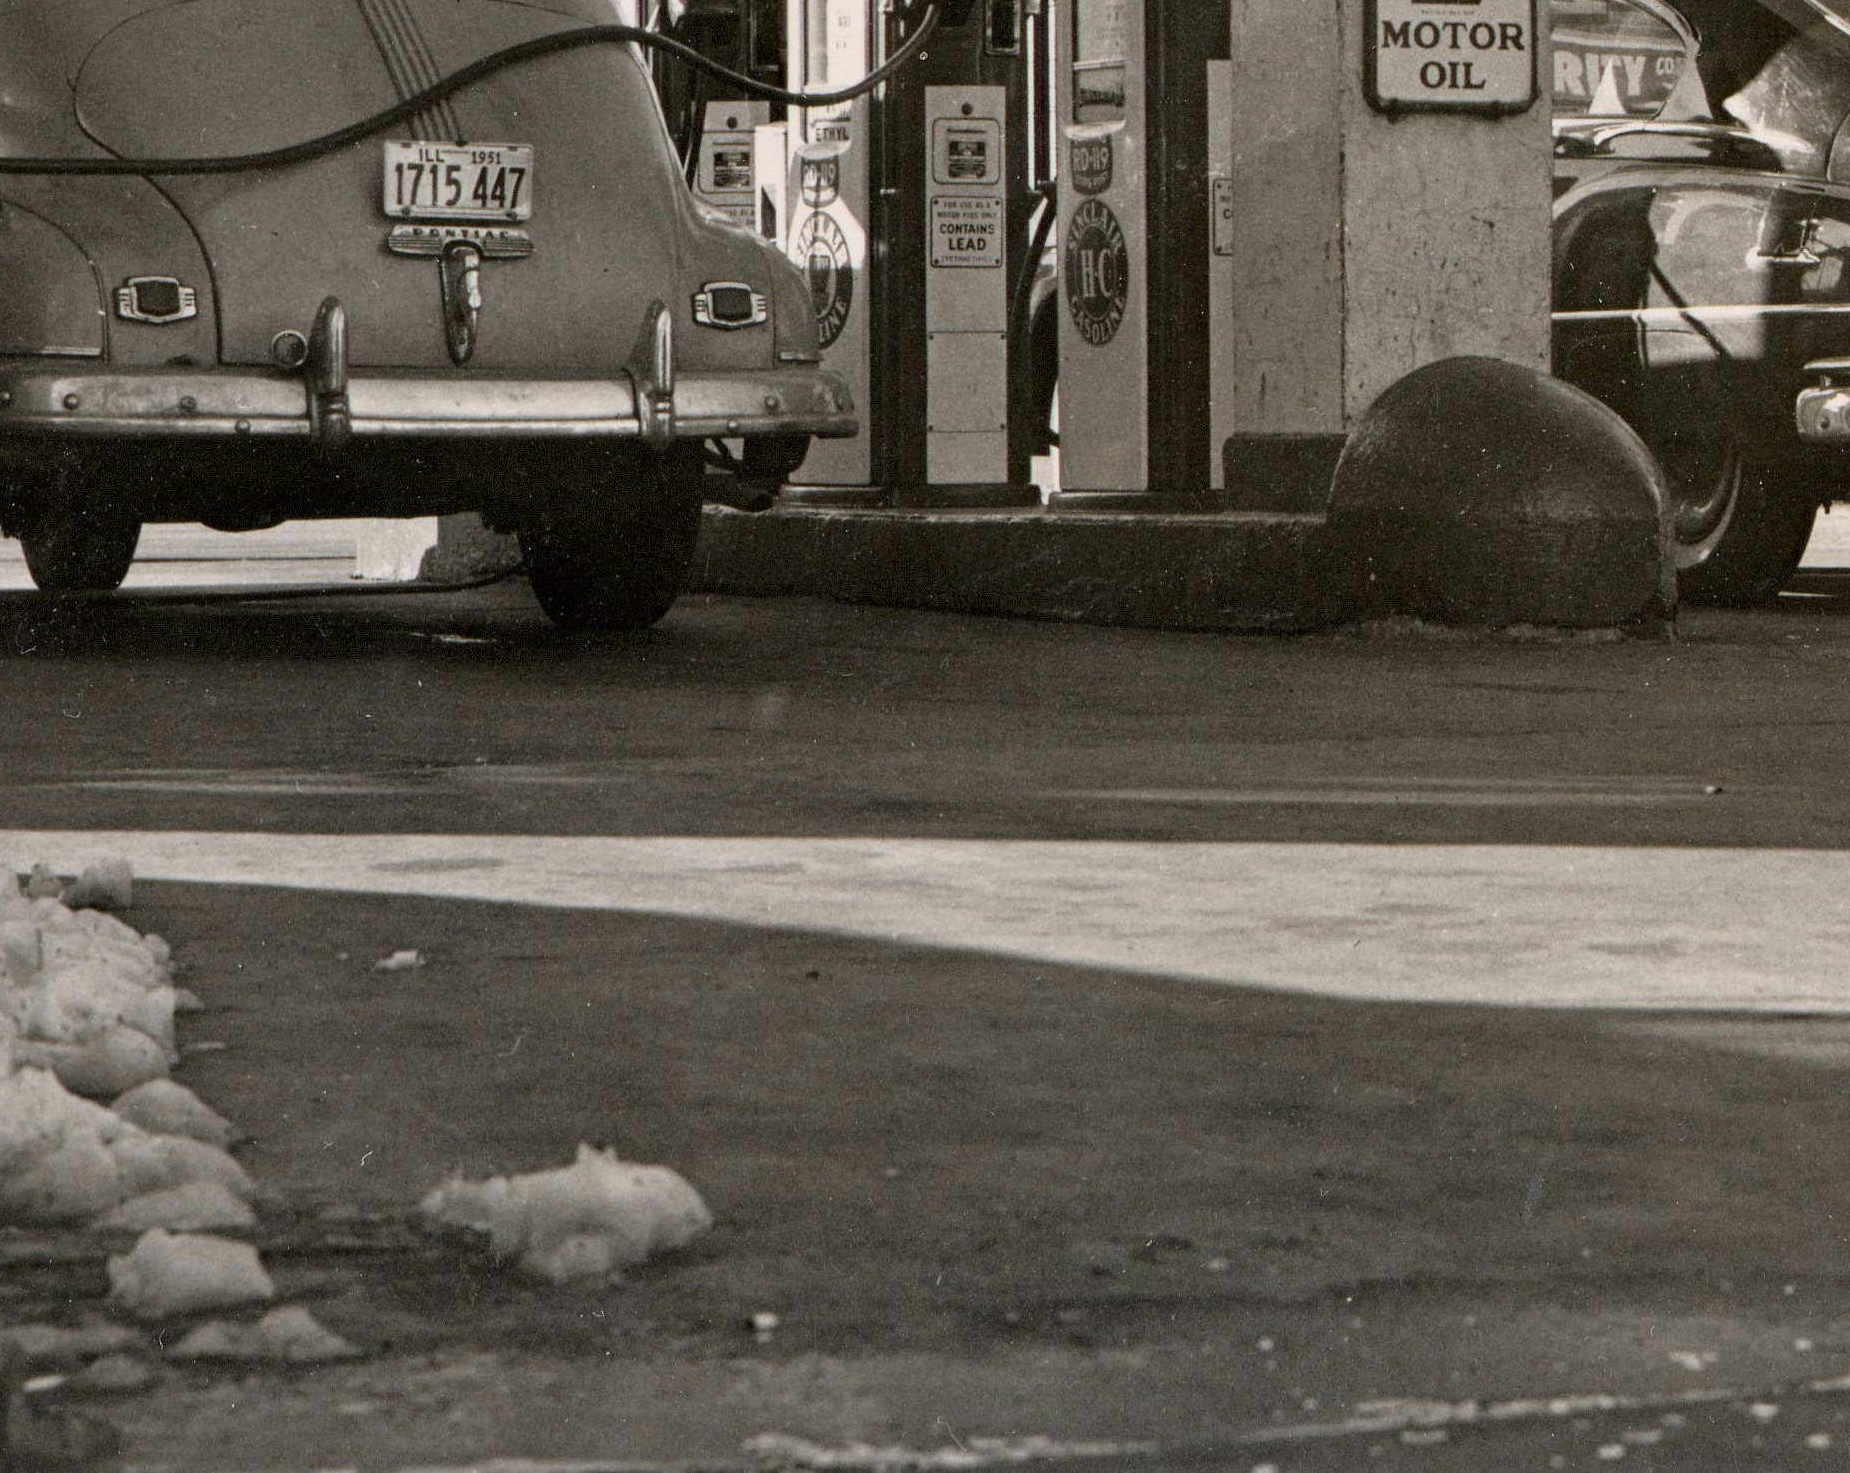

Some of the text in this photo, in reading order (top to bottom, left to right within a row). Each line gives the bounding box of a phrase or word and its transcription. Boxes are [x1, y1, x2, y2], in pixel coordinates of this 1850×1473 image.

[1381, 20, 1525, 51] MOTOR
[1419, 60, 1486, 90] OIL
[418, 148, 502, 164] ILL 1951
[394, 162, 526, 209] 1715 447
[411, 226, 509, 239] PONTIAC
[939, 223, 996, 235] CONTAINS
[1067, 203, 1123, 252] SINCLAIR
[948, 237, 987, 251] LEAD
[1070, 296, 1125, 344] GASOLINE
